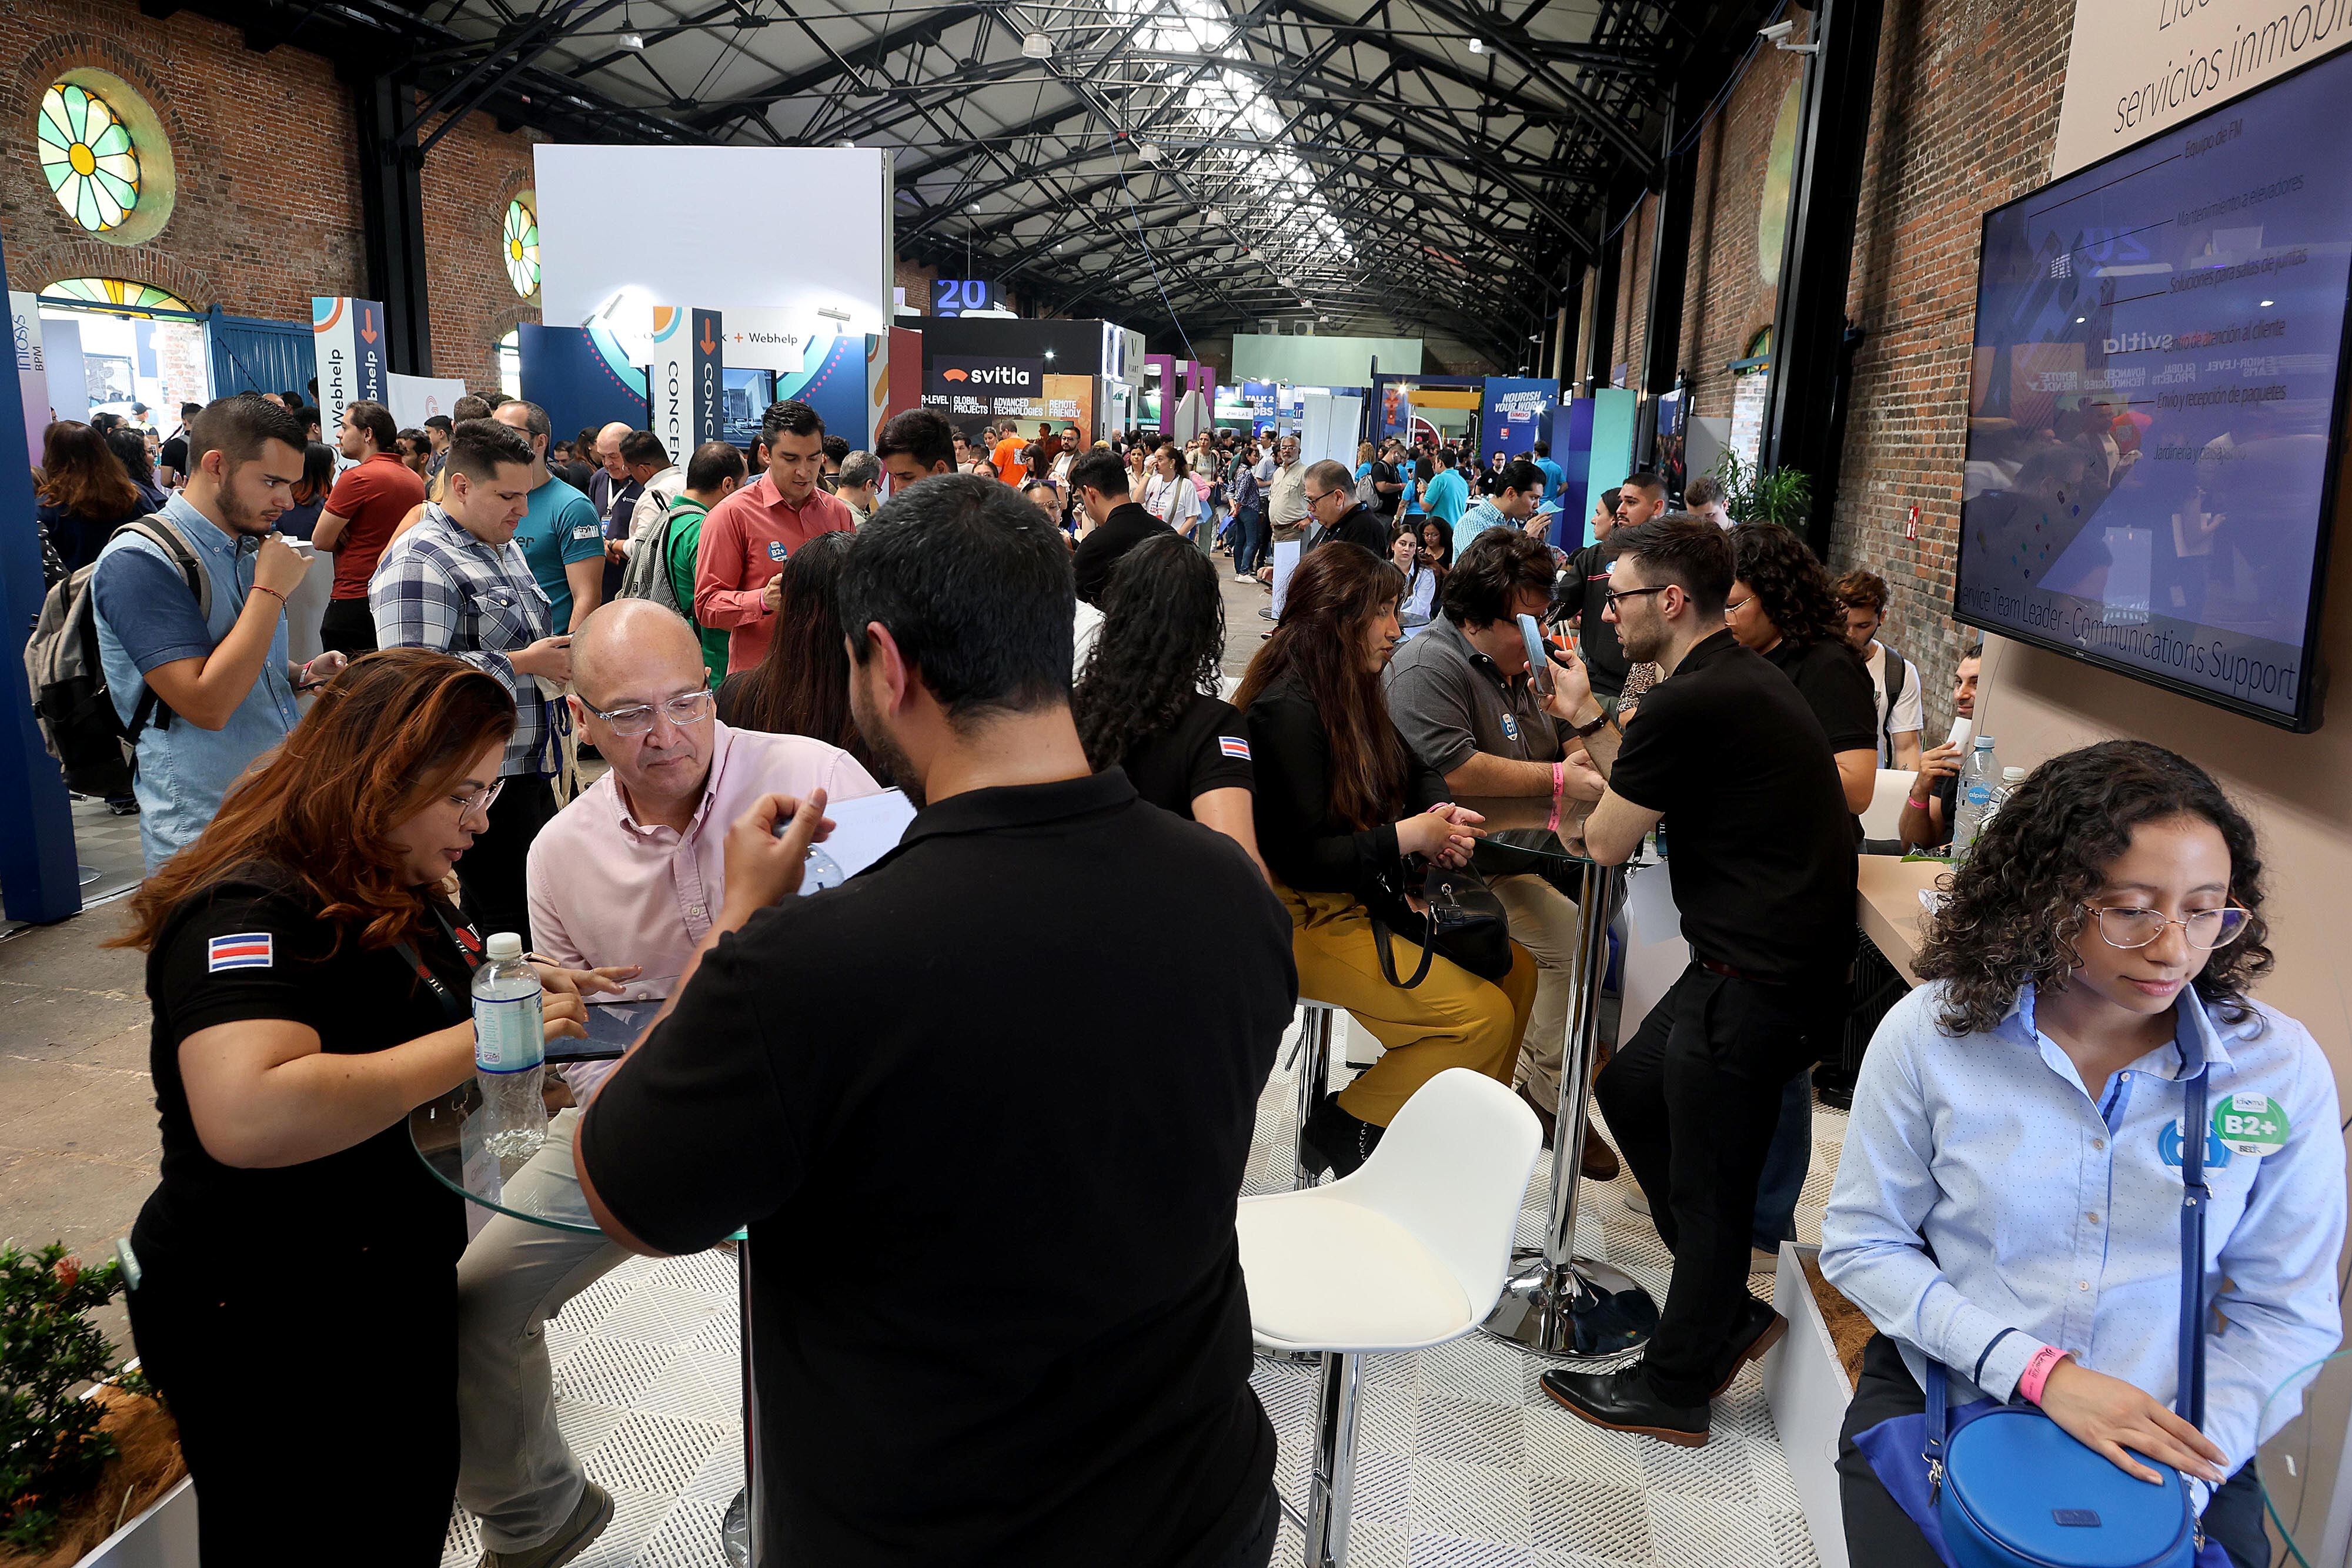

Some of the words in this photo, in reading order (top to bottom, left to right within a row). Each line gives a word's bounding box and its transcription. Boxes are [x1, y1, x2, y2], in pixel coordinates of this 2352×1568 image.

[2114, 49, 2223, 133] servicios
[2170, 270, 2213, 294] Soluciones
[937, 280, 986, 309] 20
[749, 333, 798, 346] Webhelp
[32, 346, 44, 371] BPM
[365, 351, 379, 401] bhelp
[971, 366, 1030, 385] svitla
[328, 349, 345, 428] Webhelp
[1502, 390, 1542, 403] NOURISH
[704, 363, 714, 443] CONC
[953, 404, 988, 414] PROJECTS
[954, 396, 979, 405] GLOBAL
[994, 397, 1029, 407] ADVANCED
[1049, 399, 1077, 409] REMOTE
[1495, 403, 1517, 413] YOUR
[668, 361, 680, 466] CONCEN
[994, 406, 1043, 417] TECHNOLOGIES
[1049, 408, 1081, 418] FRIENDLY
[1254, 407, 1274, 416] OBS
[1958, 579, 1991, 611] Service
[1993, 587, 2020, 620] Team
[2023, 595, 2063, 631] Leader
[2073, 607, 2205, 674] Communications
[2209, 641, 2296, 700] Support
[1969, 792, 1990, 800] alpina
[427, 978, 444, 995] JLL
[2224, 1114, 2277, 1136] B2+
